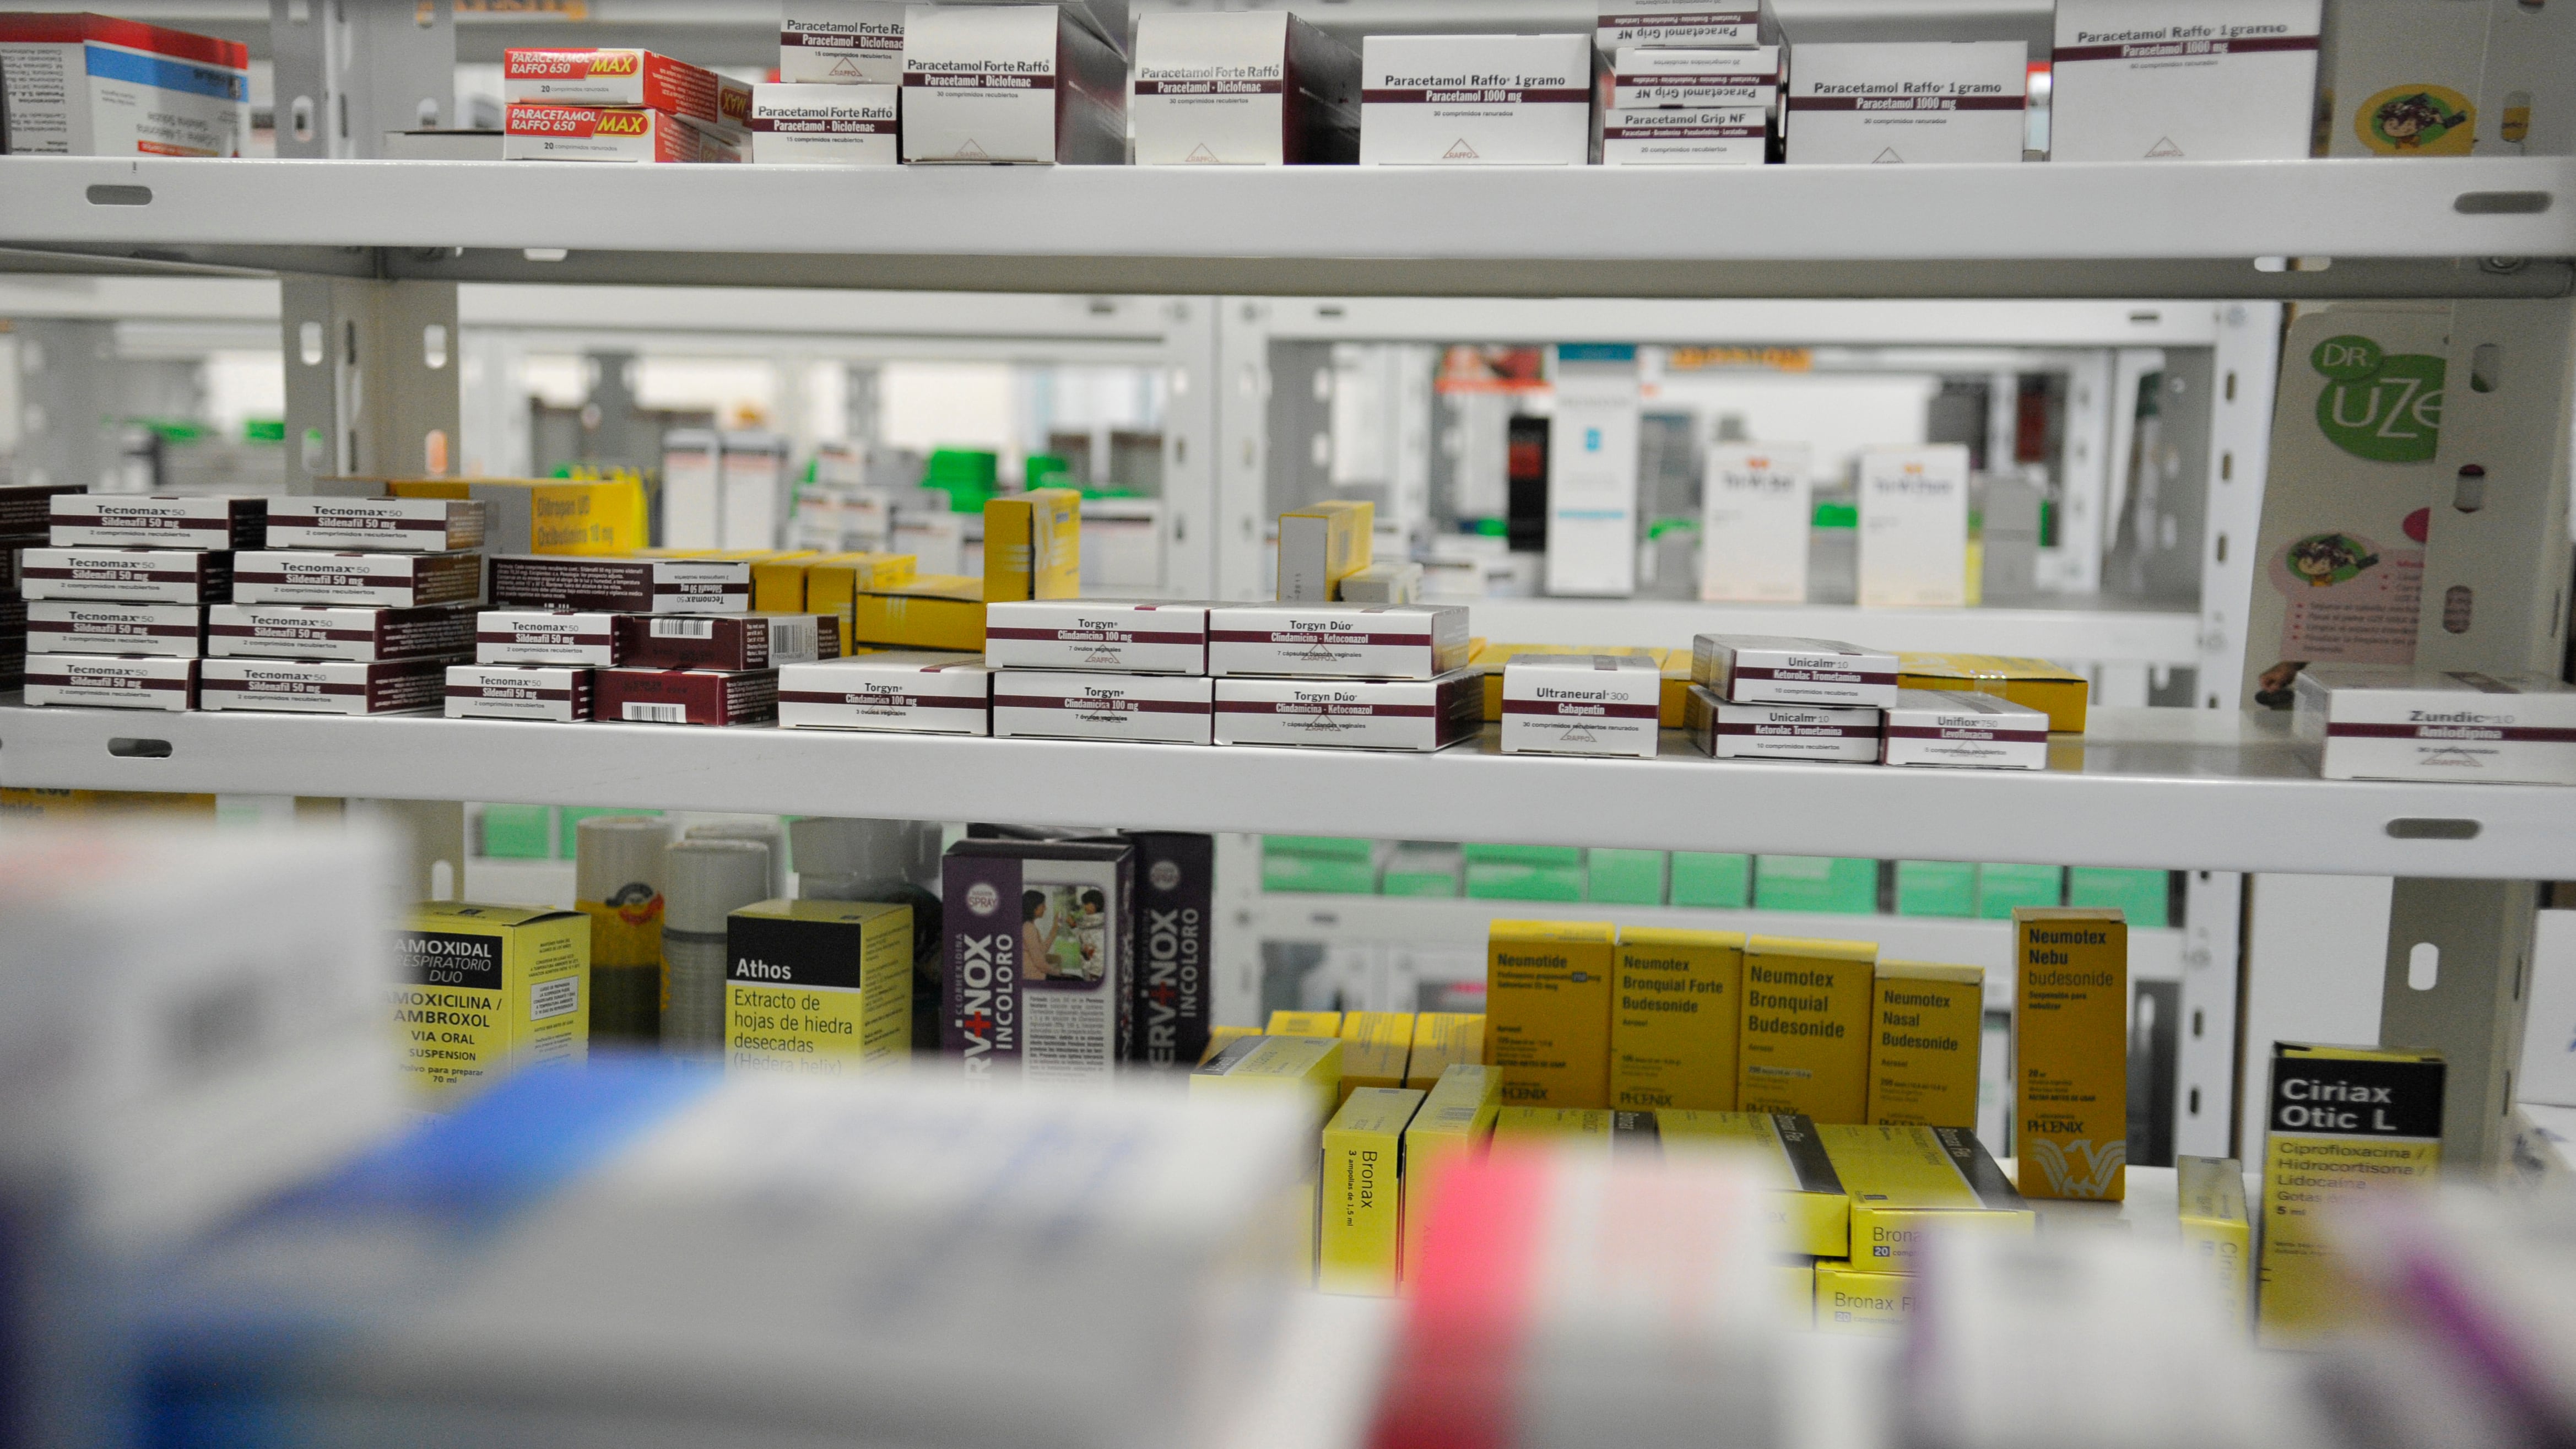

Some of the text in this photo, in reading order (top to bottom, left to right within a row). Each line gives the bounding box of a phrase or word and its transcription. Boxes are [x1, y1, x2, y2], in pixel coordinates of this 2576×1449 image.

[2078, 28, 2166, 42] Paracetamol
[2231, 24, 2287, 37] gramo
[511, 51, 634, 72] PARACETAMOL MAX
[908, 60, 982, 71] Paracetamol
[984, 61, 1015, 72] Forte
[511, 63, 571, 74] RAFFO 650
[1141, 67, 1213, 78] Paracetamol
[1215, 66, 1245, 78] Forte
[925, 74, 1031, 88] Paracetamol Diclofenac
[1385, 75, 1465, 86] Paracetamol
[1516, 75, 1520, 85] 1
[1524, 77, 1565, 87] gramo
[1636, 87, 1756, 99] Paracetamol Grip NF
[1814, 83, 1898, 93] Paracetamol
[1950, 83, 1956, 93] 1
[1958, 83, 2001, 95] gramo
[1426, 90, 1522, 103] Paracetamol 1000 mg
[759, 106, 829, 117] Paracetamol
[831, 107, 859, 117] Forte
[1625, 113, 1746, 124] Paracetamol Grip NF
[96, 505, 166, 516] Tecnomax
[313, 506, 385, 517] Tecnomax
[318, 517, 396, 530] Sildenafil 50 mg
[512, 621, 565, 631] Tecnomax
[1078, 619, 1113, 630] Torgyn
[1290, 620, 1351, 631] Torgyn Dúo
[516, 633, 574, 646] Sildenafil 50 mg
[1058, 630, 1133, 643] Clindamicina 100 mg
[1271, 632, 1368, 644] Clindamicina Ketoconazol
[1789, 657, 1833, 668] Unicalm
[1774, 669, 1861, 682] Ketorolac Trometamina
[865, 683, 899, 694] Torgyn
[1537, 688, 1606, 700] Ultraneural
[846, 694, 917, 707] Clindamicina 100 mg
[1558, 703, 1605, 716] Gabapentin
[1938, 716, 1976, 727] Uniflox
[2410, 710, 2485, 723] Zundic
[968, 896, 998, 908] SPRAY
[2030, 928, 2106, 945] Neumotex
[394, 938, 492, 958] AMOXIDAL
[397, 955, 491, 971] RESPIRATORIO
[1180, 908, 1199, 1018] INCOLORO
[1498, 954, 1567, 969] Neumotide
[2029, 949, 2069, 965] Nebu
[736, 958, 792, 980] Athos
[1624, 956, 1690, 972] Neumotex
[429, 970, 463, 983] DUO
[1751, 966, 1834, 987] Neumotex
[2029, 971, 2113, 987] budesonide
[1623, 976, 1723, 994] Bronquial Forte
[996, 934, 1013, 1050] INCOLORO
[735, 989, 820, 1011] Extracto de
[1623, 997, 1698, 1013] Budesonide
[1750, 990, 1828, 1014] Bronquial
[1884, 990, 1950, 1008] Neumotex
[394, 1010, 490, 1028] AMBROXOL
[735, 1010, 853, 1035] hojas de hiedra
[1884, 1012, 1920, 1027] Nasal
[1749, 1016, 1844, 1038] Budesonide
[412, 1030, 475, 1045] VIA ORAL
[734, 1033, 814, 1053] desecadas
[1882, 1033, 1958, 1051] Budesonide
[410, 1048, 477, 1061] SUSPENSION
[2281, 1078, 2393, 1104] Ciriax
[2281, 1105, 2397, 1131] Otic L
[2279, 1142, 2411, 1159] Ciprofloxacina
[2279, 1159, 2414, 1175] Hidrocortisona
[1361, 1151, 1378, 1208] Bronax
[1347, 1192, 1354, 1201] de
[1347, 1218, 1354, 1226] ml
[1874, 1246, 1888, 1256] 20
[1835, 1292, 1893, 1311] Bronax
